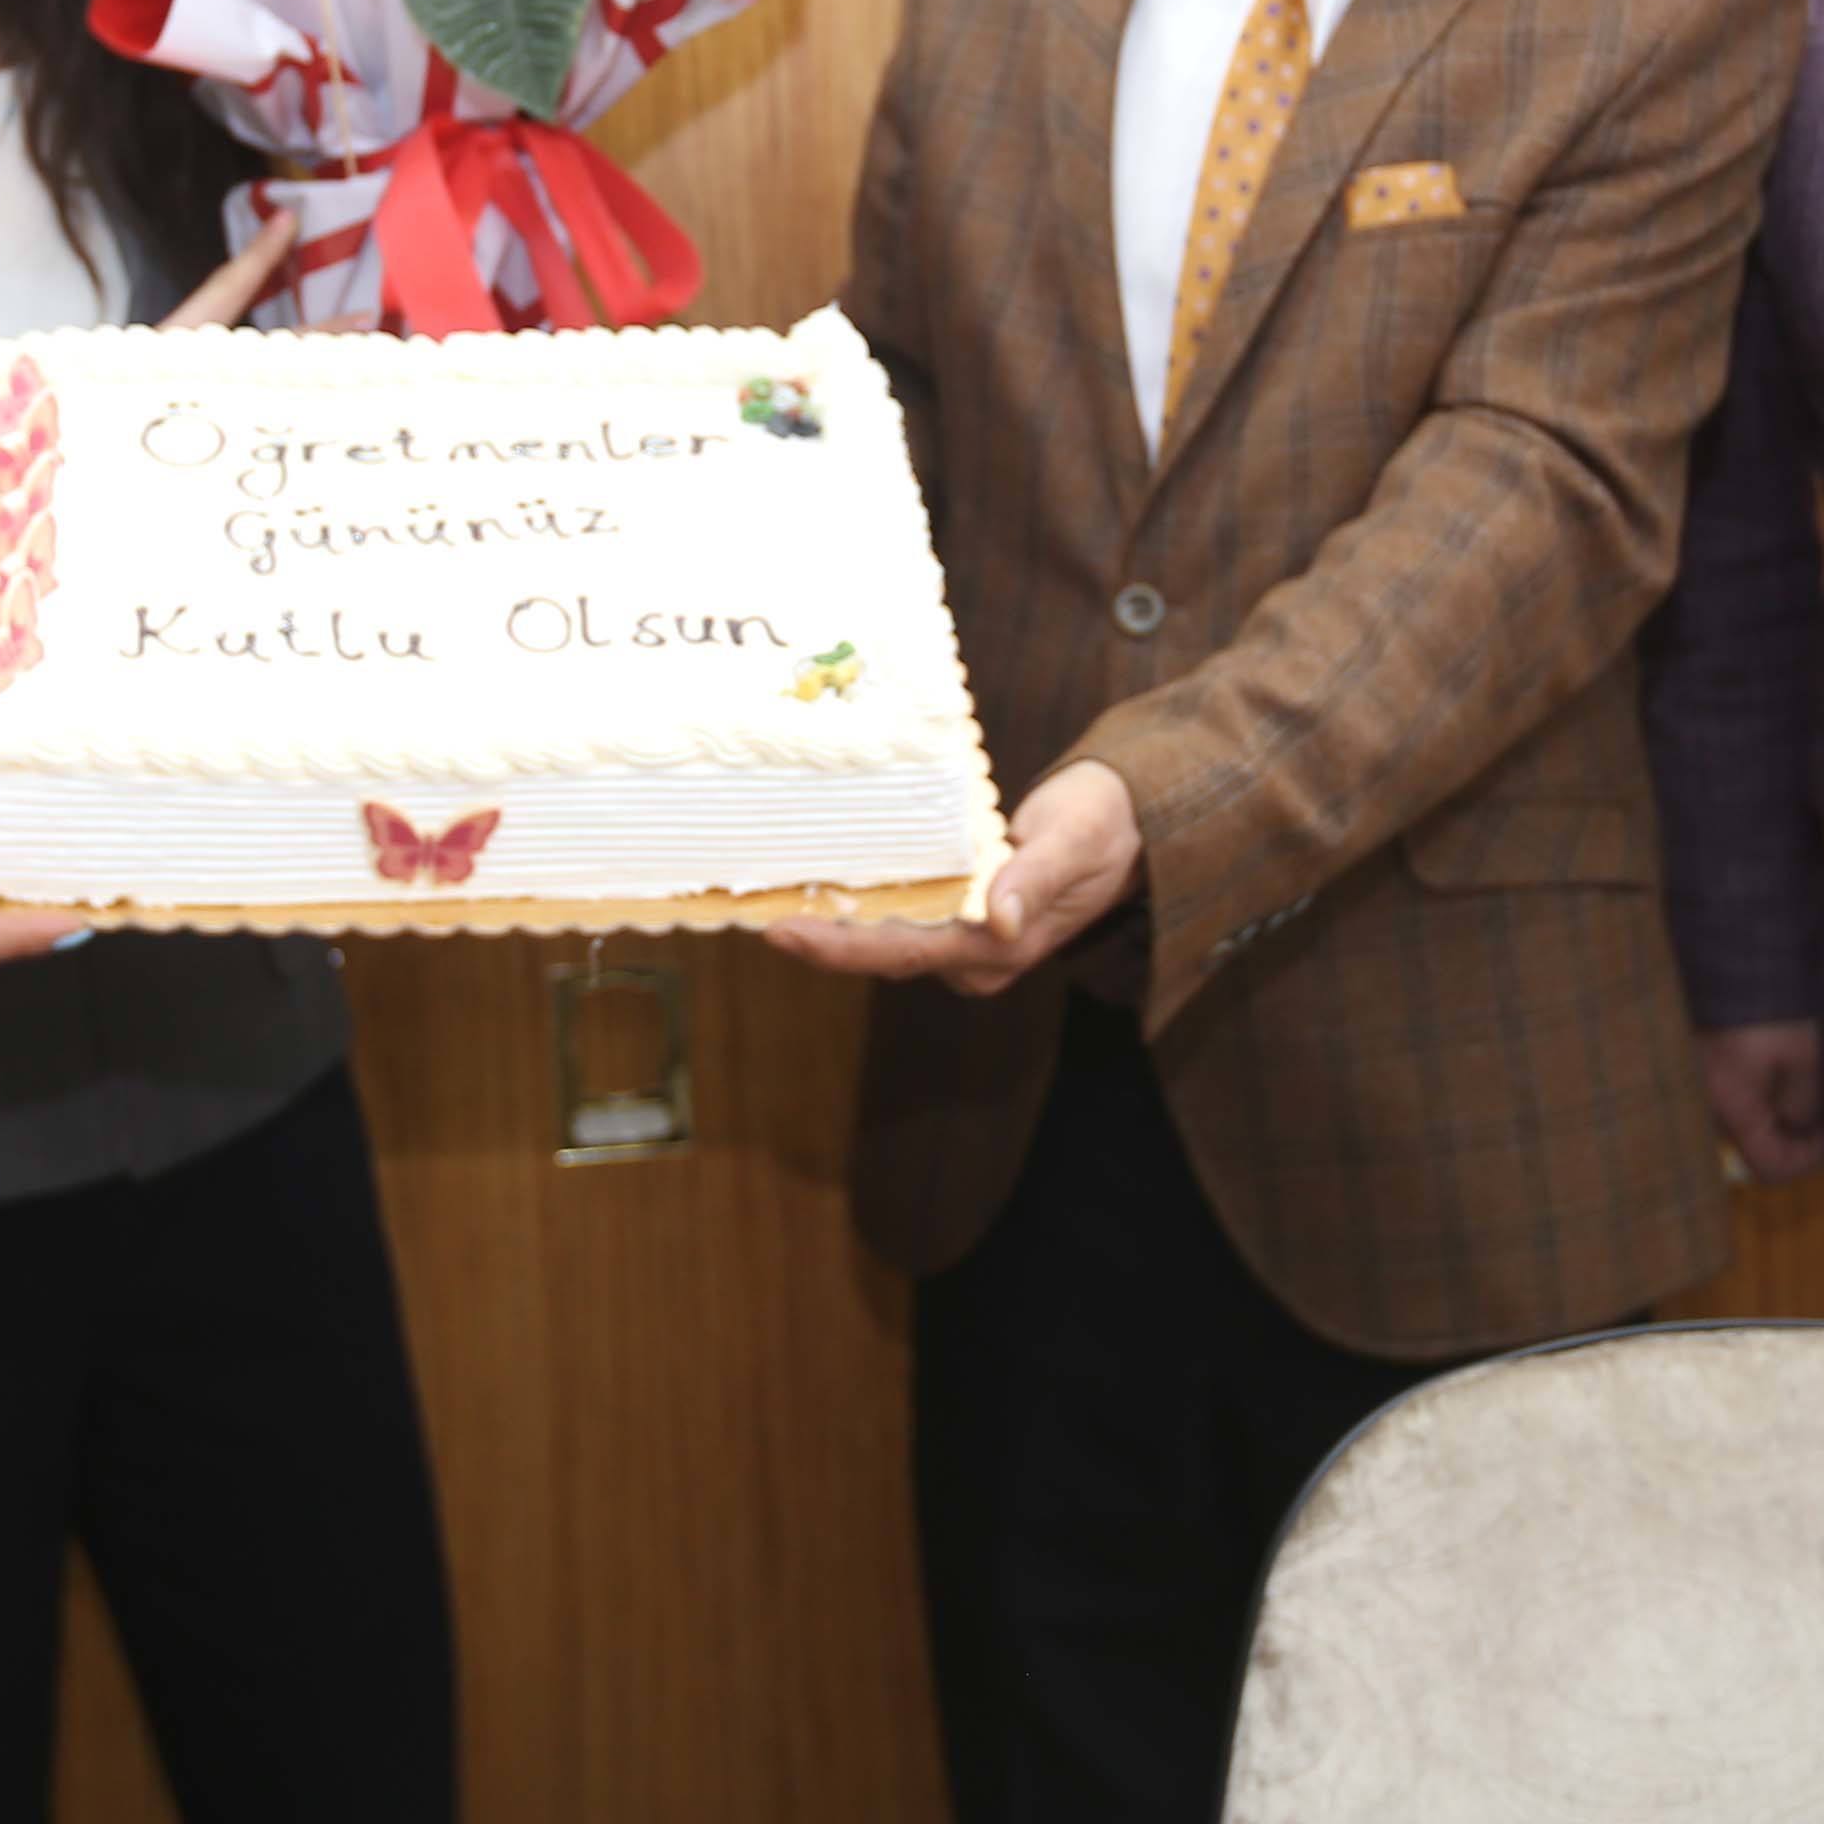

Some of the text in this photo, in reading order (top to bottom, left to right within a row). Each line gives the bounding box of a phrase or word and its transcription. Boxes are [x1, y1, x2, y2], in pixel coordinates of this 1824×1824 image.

[140, 400, 730, 500] Öğretmenler
[118, 595, 789, 663] Kutlu Olsun
